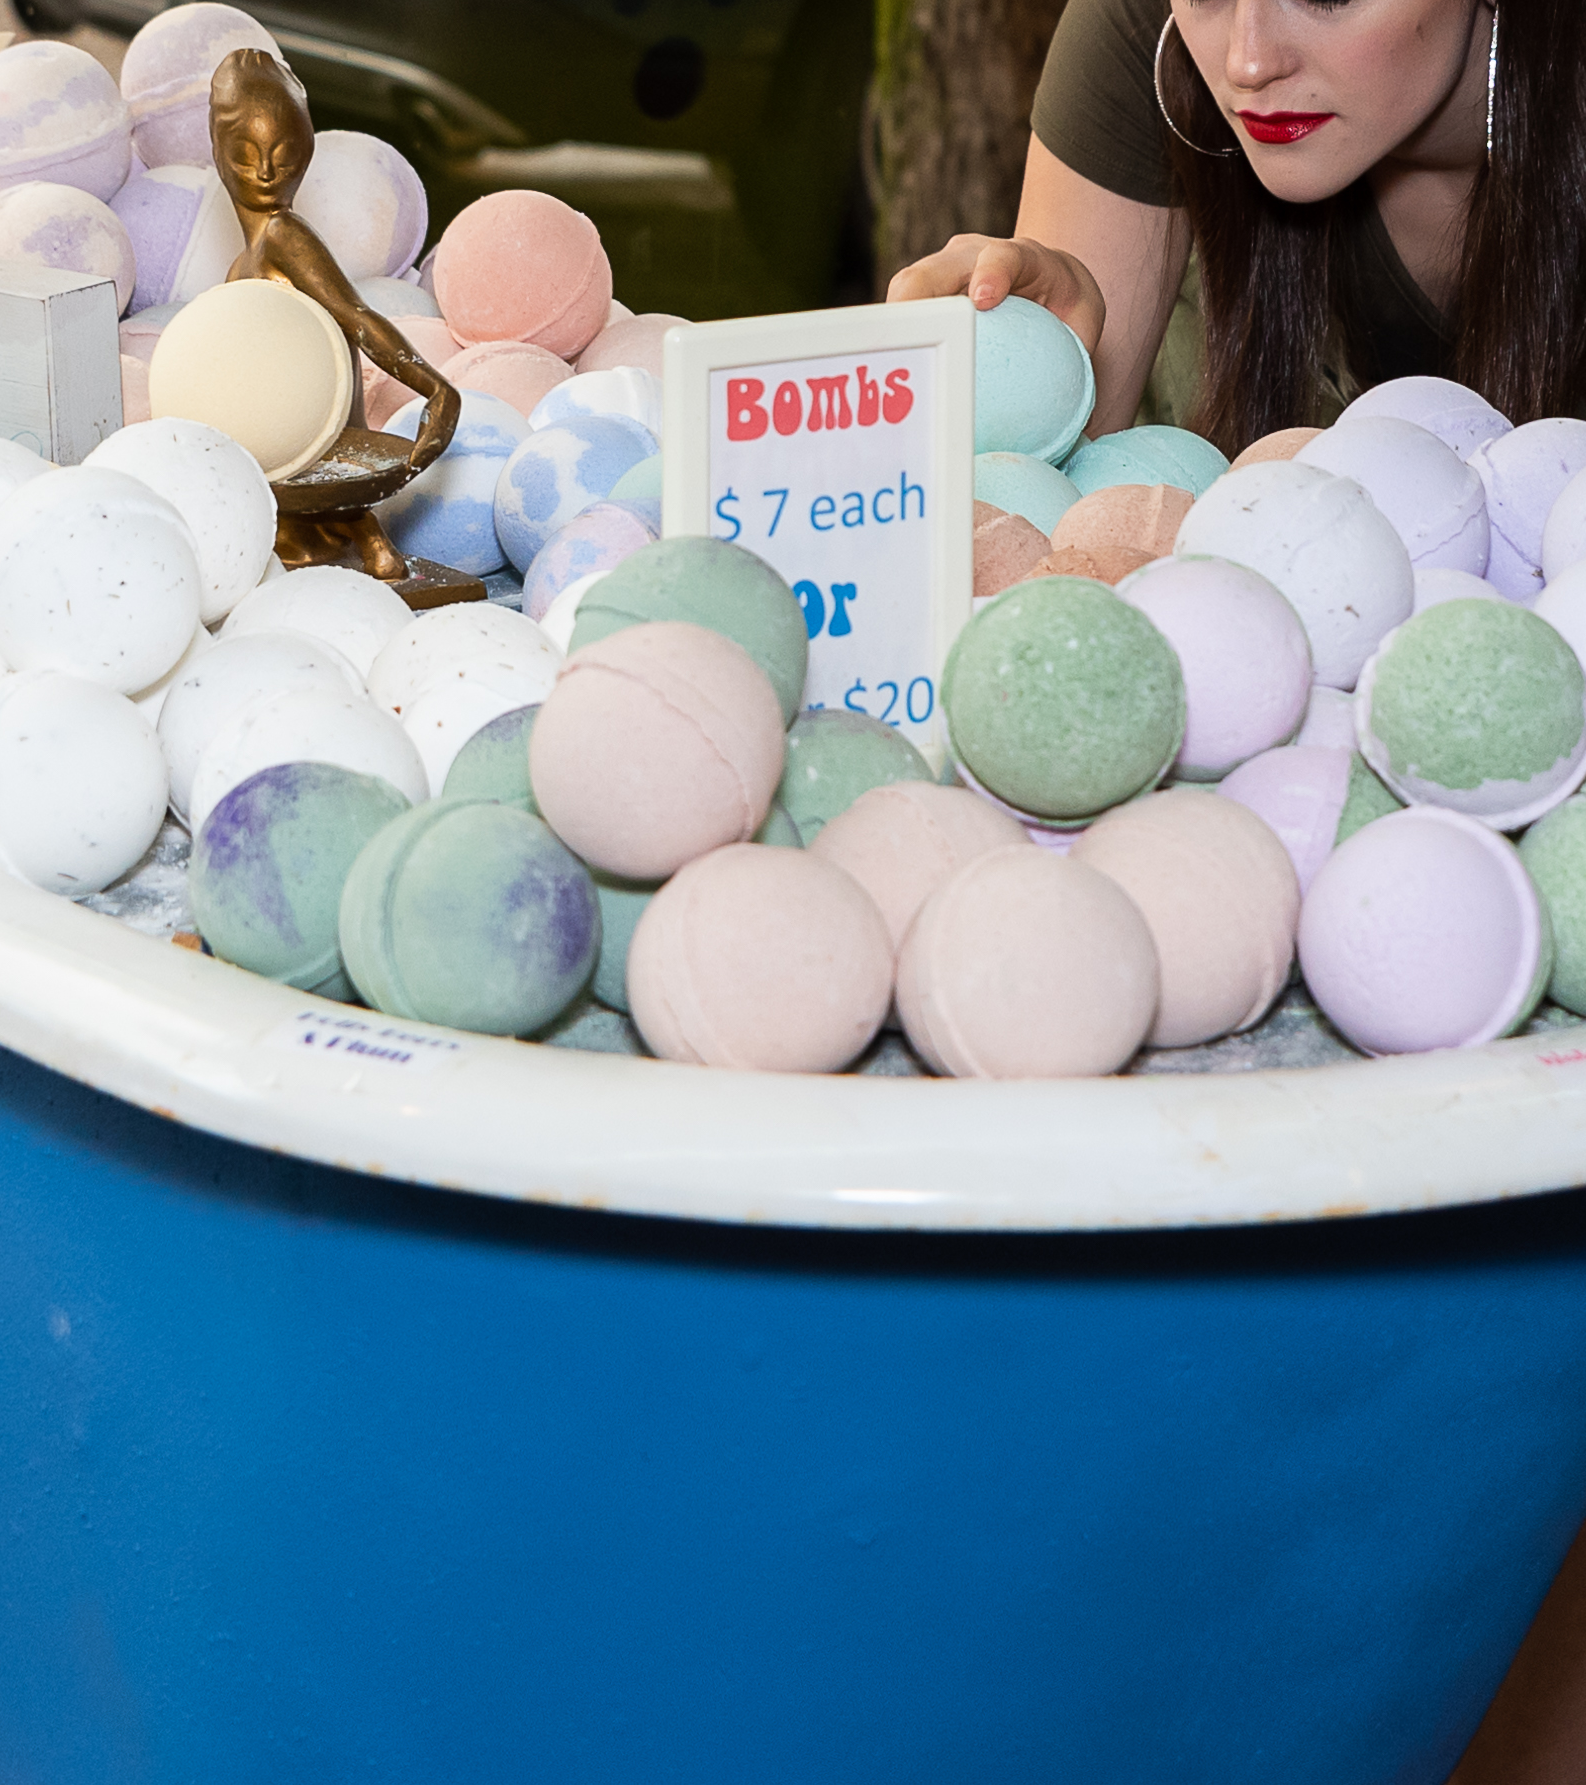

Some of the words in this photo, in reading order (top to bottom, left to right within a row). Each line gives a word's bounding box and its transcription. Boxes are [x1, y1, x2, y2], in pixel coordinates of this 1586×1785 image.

[726, 364, 915, 442] Bombs
[763, 488, 790, 538] 7
[810, 470, 926, 532] each
